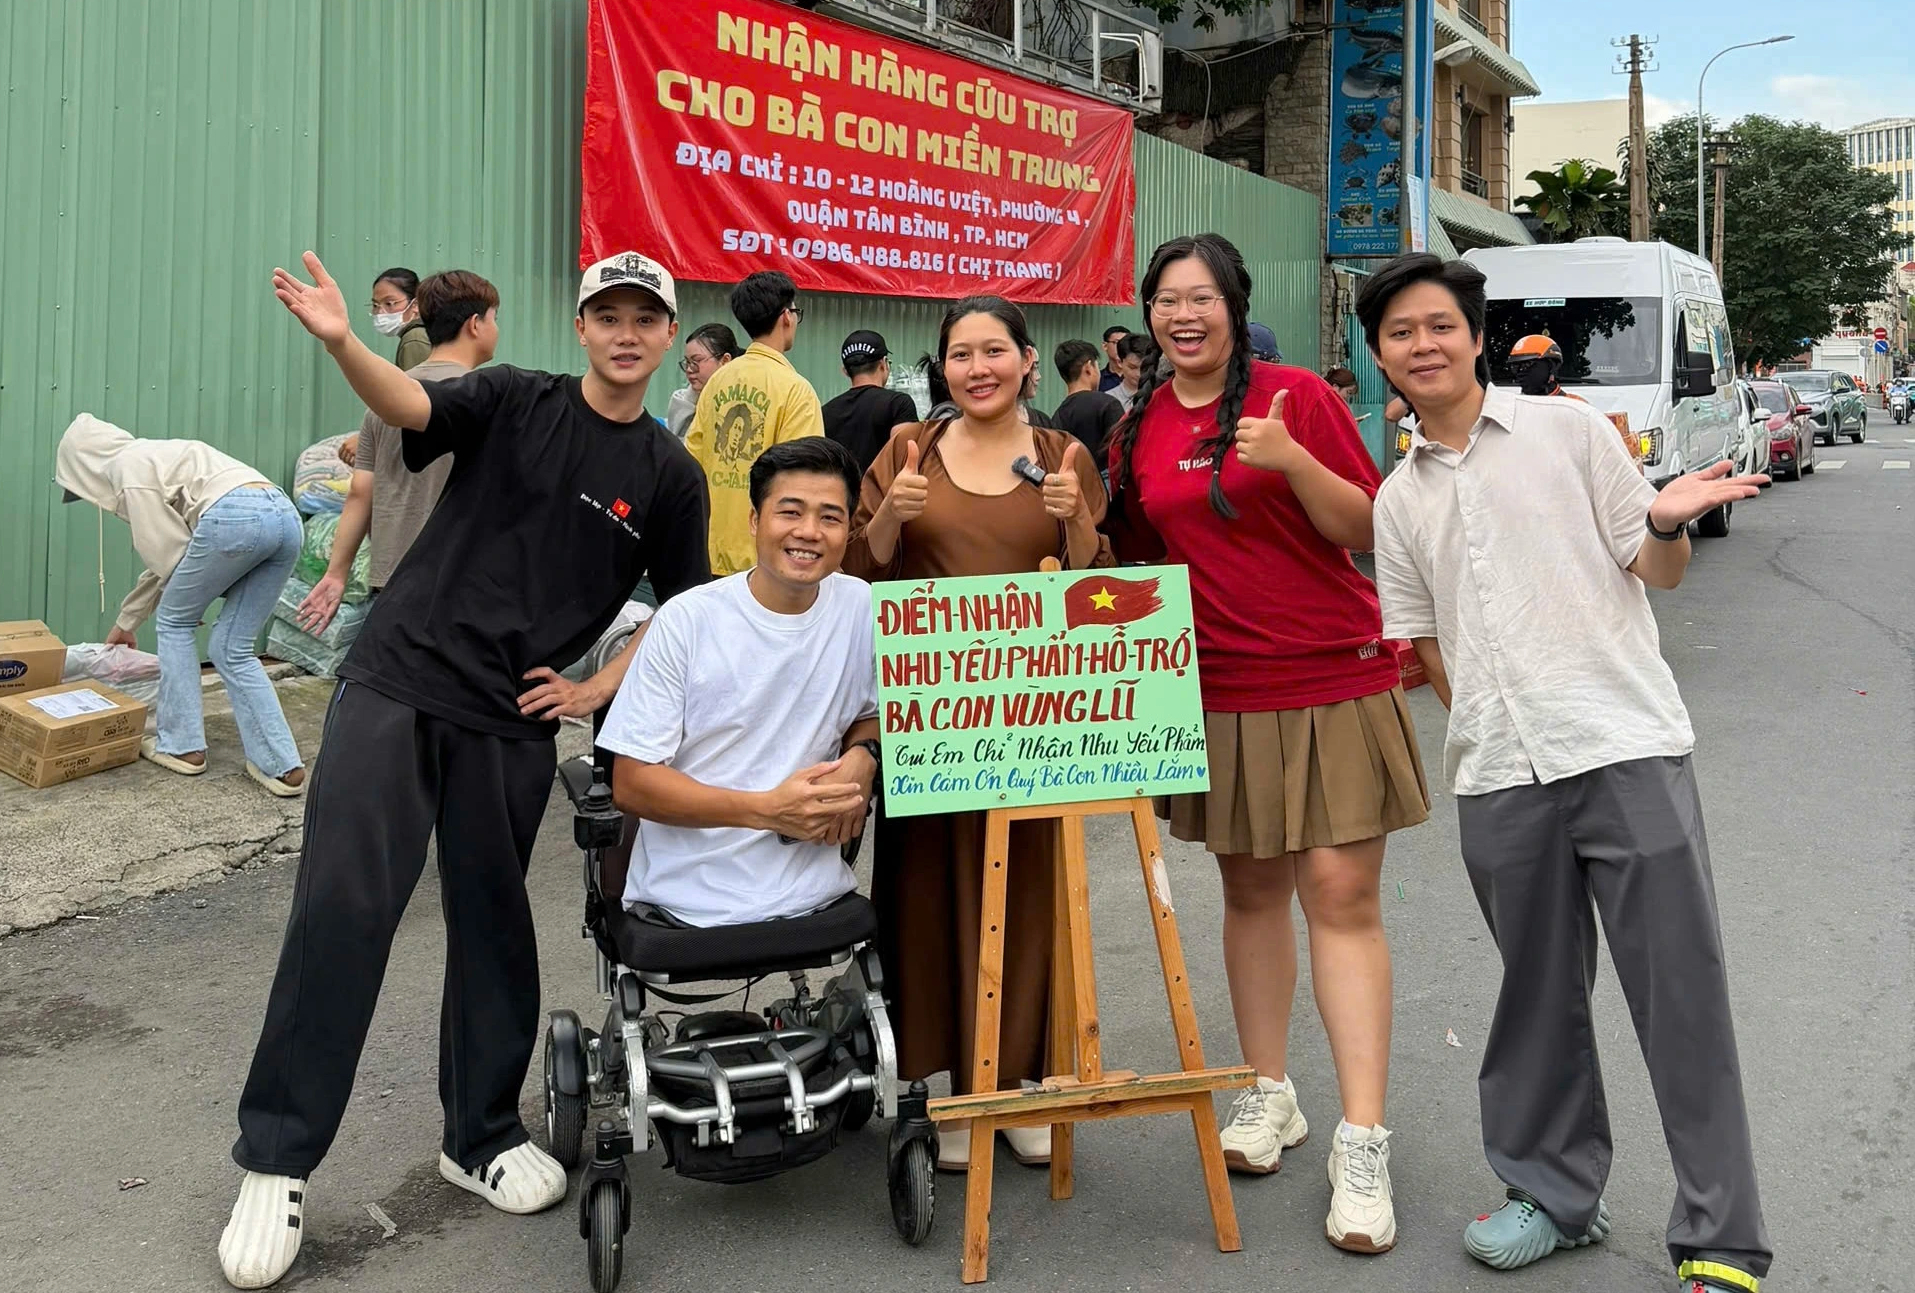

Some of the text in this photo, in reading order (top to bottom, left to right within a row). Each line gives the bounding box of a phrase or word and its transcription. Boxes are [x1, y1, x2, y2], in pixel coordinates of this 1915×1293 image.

[717, 11, 1078, 148] NHẬN HÀNG CỨU TRỢ
[657, 69, 1101, 192] CHO BÀ CON MIỀN TRUNG
[676, 141, 732, 175] ĐỊA
[740, 152, 783, 183] CHỈ
[803, 165, 832, 190] 10
[850, 174, 875, 197] 12
[879, 178, 945, 207] HOÀNG
[950, 189, 998, 218] VIỆT,
[1001, 199, 1064, 225] PHƯỜNG
[787, 198, 848, 231] QUẬN
[853, 205, 895, 234] TÂN
[900, 212, 949, 240] BÌNH
[964, 224, 992, 246] TP.
[995, 229, 1029, 250] HCM
[1371, 242, 1385, 250] 222
[723, 228, 773, 255] SĐT
[792, 238, 944, 272] 0986.488.816
[713, 383, 772, 416] JAMAICA
[886, 678, 1141, 733] BÀ CON VÙNG LŨ
[931, 741, 965, 765] Em
[973, 732, 1013, 762] Chỉ
[1017, 735, 1074, 762] Nhận
[1080, 732, 1119, 756] Nhu
[1127, 724, 1159, 755] Yếu
[1160, 723, 1205, 752] Phẩm
[890, 774, 924, 796] Xin
[929, 768, 971, 793] Cảm
[1007, 767, 1037, 798] Quý
[1040, 764, 1064, 788] Bà
[1067, 763, 1098, 785] Con
[1102, 760, 1149, 783] Nhiều
[1153, 753, 1194, 781] Lắm
